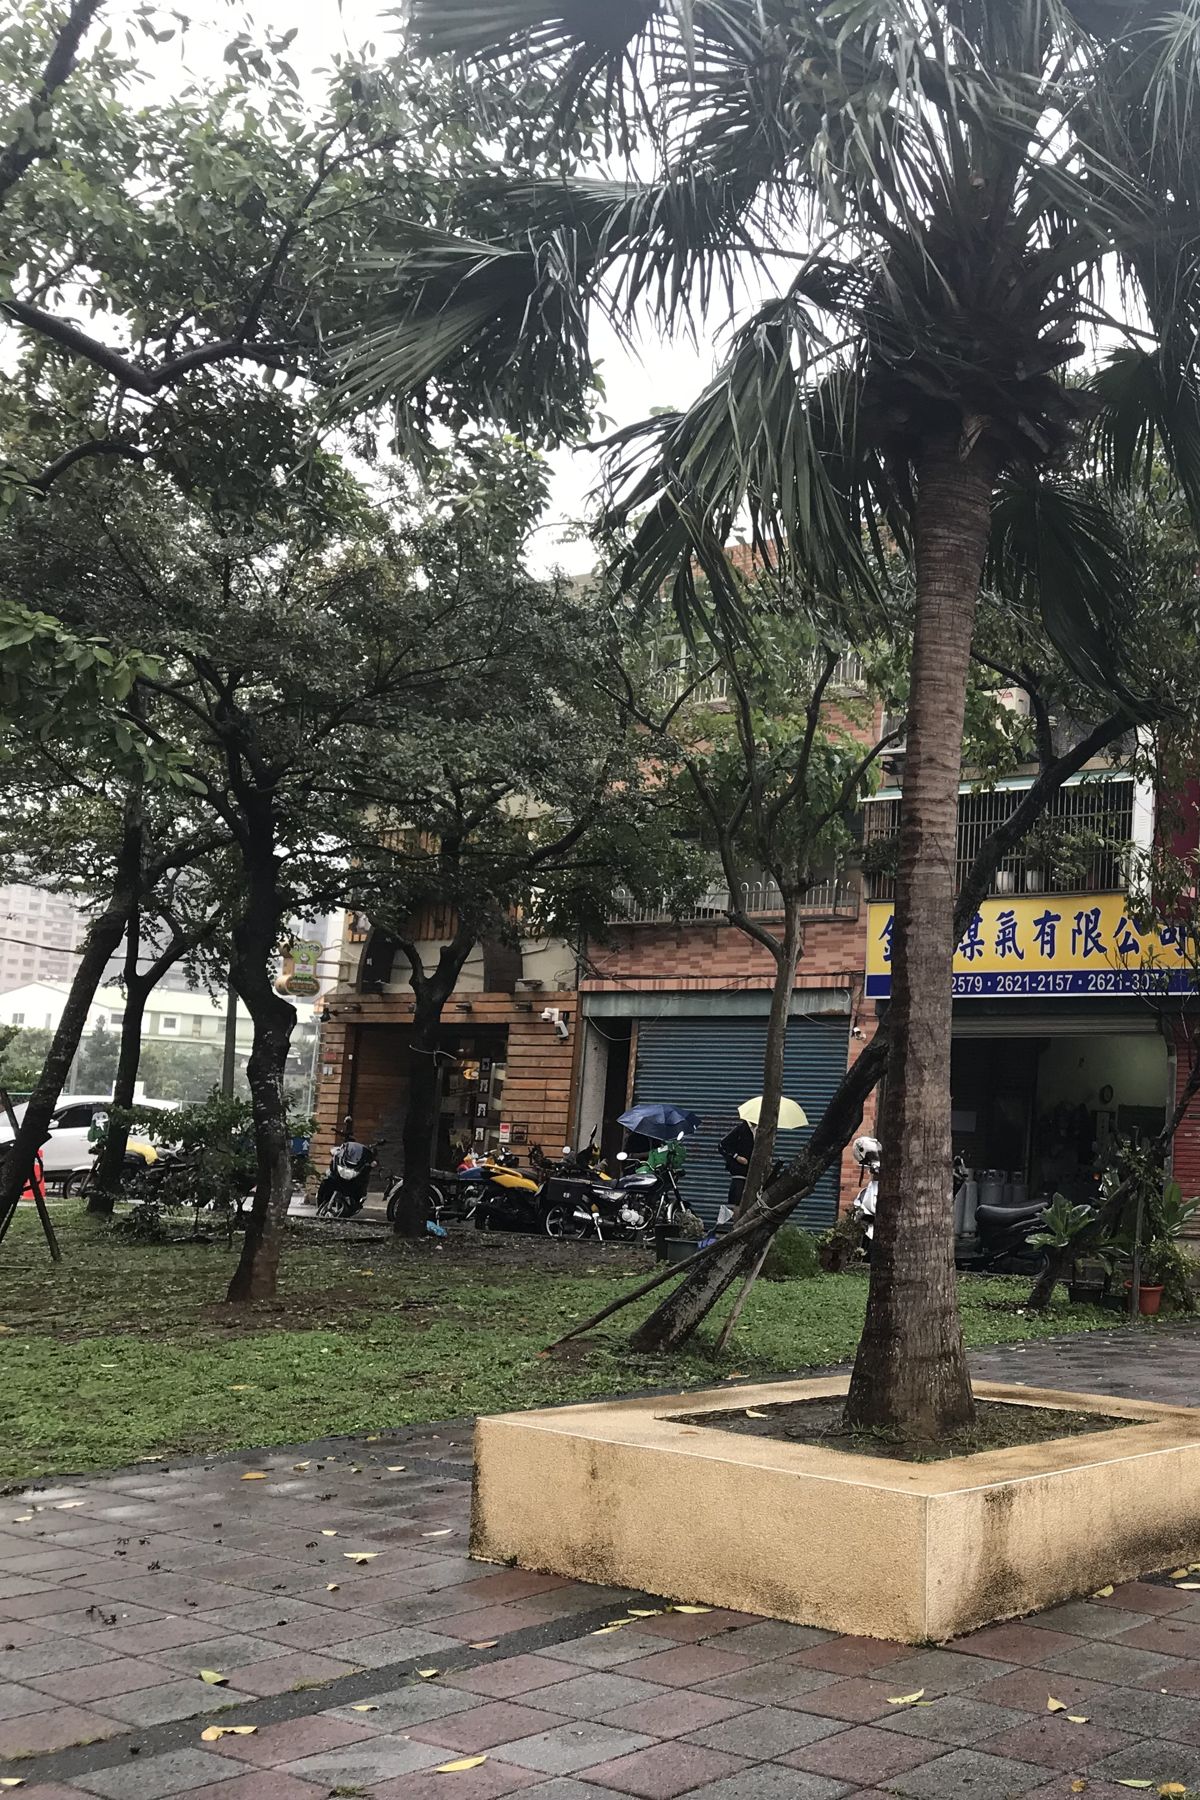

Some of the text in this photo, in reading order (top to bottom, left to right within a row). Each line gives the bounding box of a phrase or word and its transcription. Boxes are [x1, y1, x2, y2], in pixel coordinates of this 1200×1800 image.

[879, 908, 1188, 962] 煤氣有限公司
[997, 974, 1073, 992] 2621-2157
